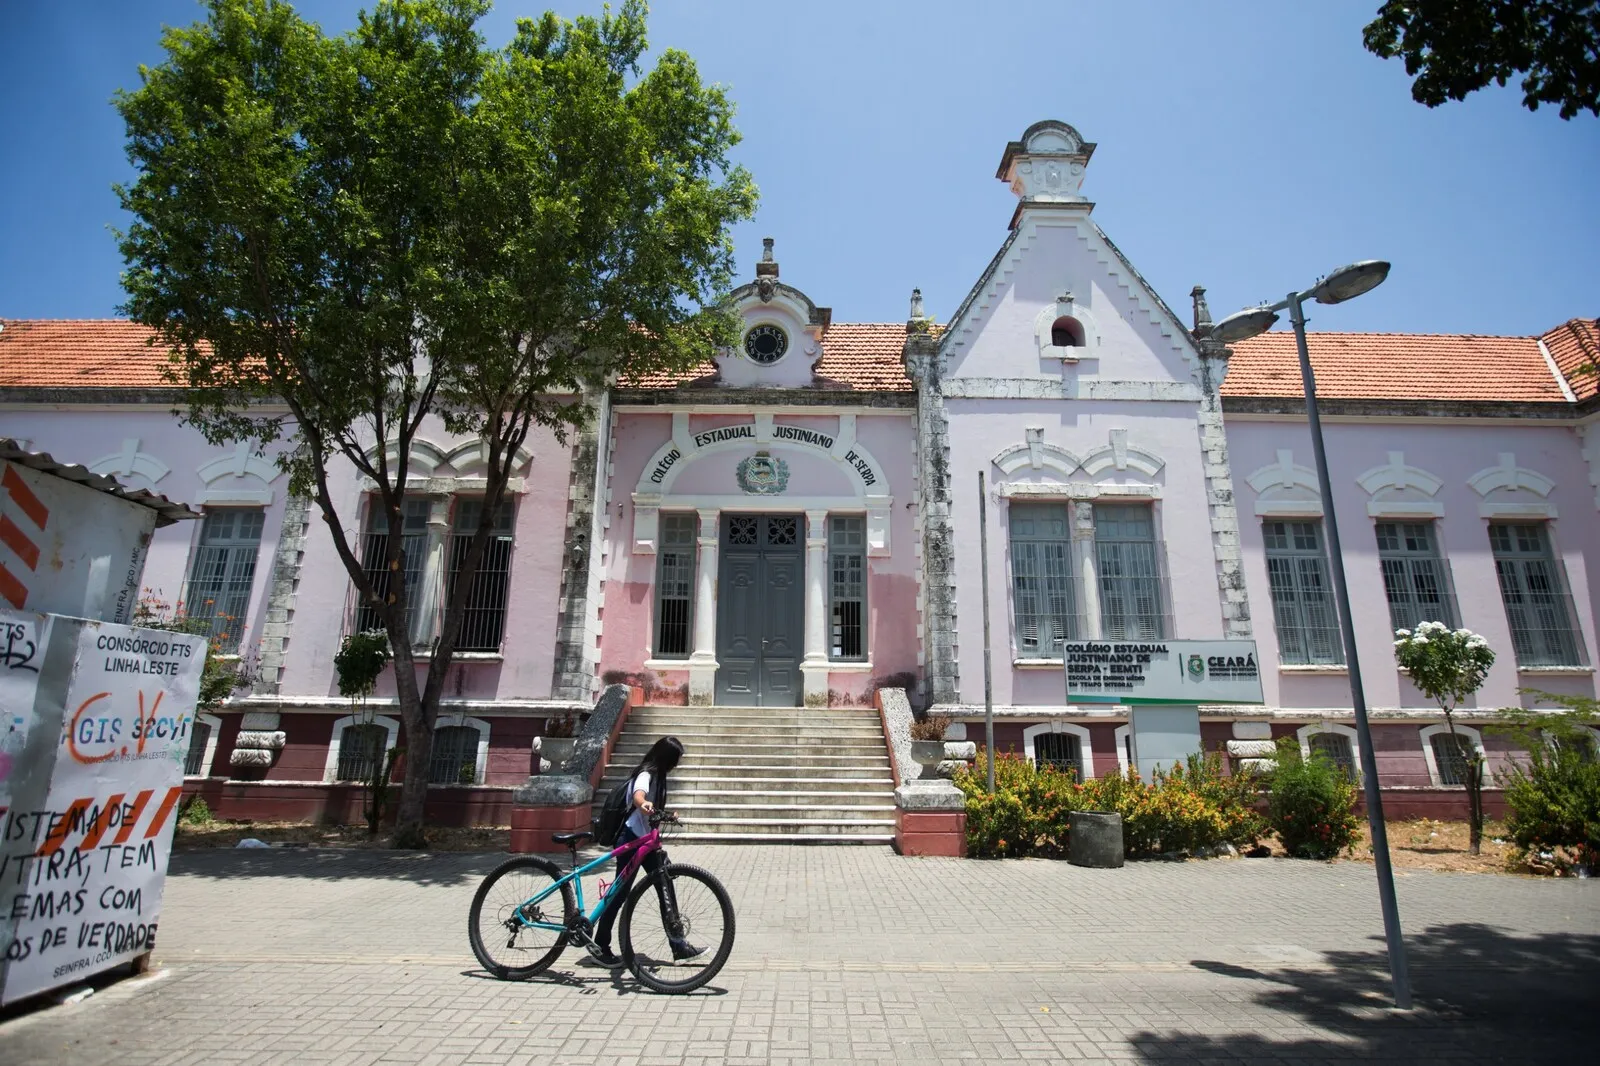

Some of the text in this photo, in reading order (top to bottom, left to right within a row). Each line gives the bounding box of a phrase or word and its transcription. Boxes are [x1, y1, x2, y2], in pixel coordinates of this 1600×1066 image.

[650, 425, 877, 487] COLÉGIO ESTADUAL JUSTINIANO DE SERPA
[114, 589, 128, 624] EINFRA
[0, 622, 25, 640] TS
[97, 635, 192, 658] CONSÓRCIO FTS
[1066, 642, 1169, 653] COLÉGIO ESTADUAL
[104, 657, 180, 676] LINHA LESTE
[1067, 654, 1151, 663] JUSTINIANO DE
[1067, 664, 1102, 673] SERPA
[1110, 664, 1142, 673] EEMTI
[1207, 652, 1256, 667] CEARÁ
[0, 802, 136, 842] ISTEMA DE
[99, 839, 156, 874] TEM
[99, 885, 142, 916] COM
[0, 936, 34, 962] OS
[39, 926, 67, 955] DE
[77, 920, 158, 953] VERDADE
[53, 957, 90, 979] SEINFRA
